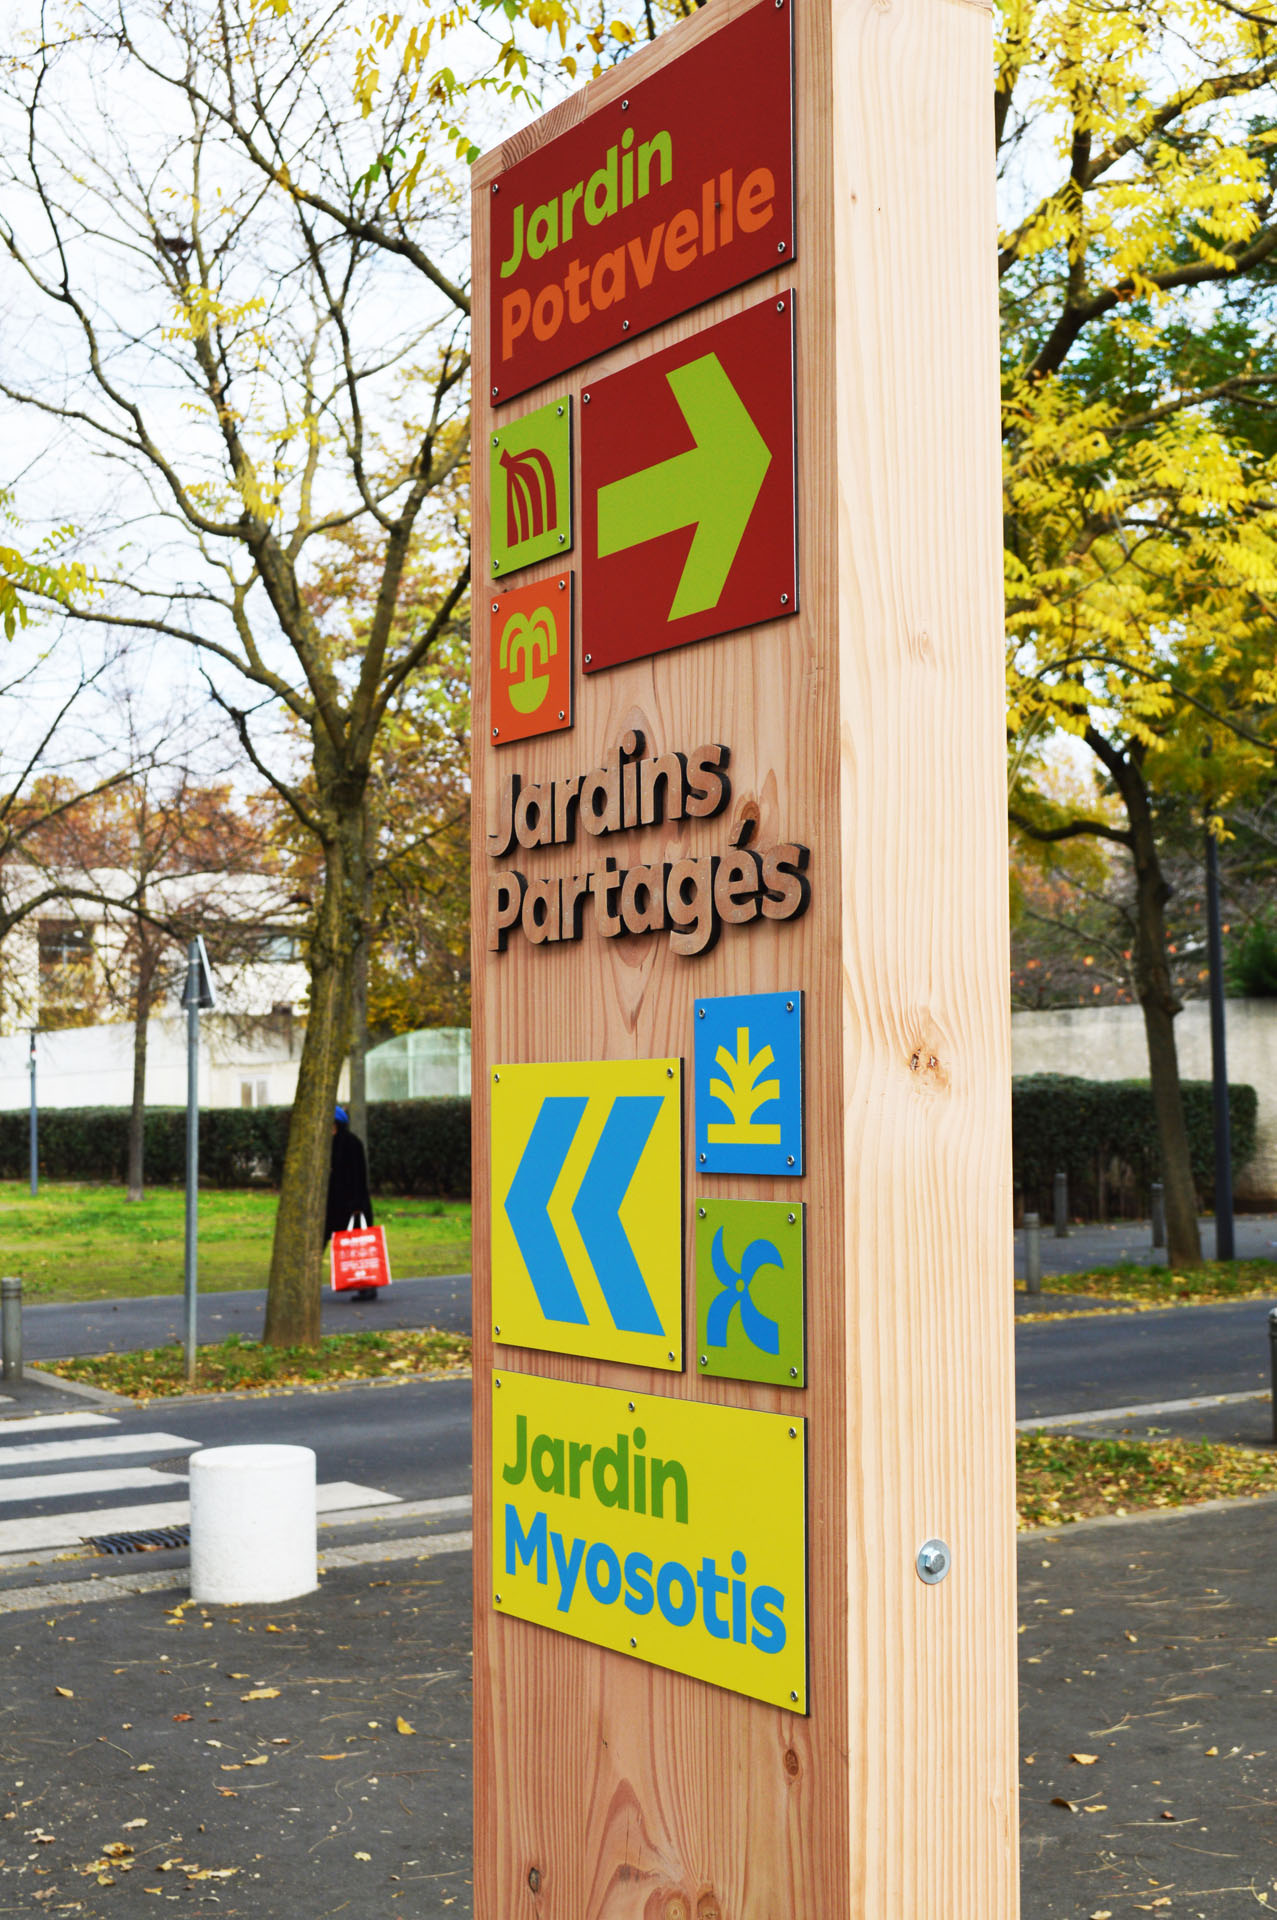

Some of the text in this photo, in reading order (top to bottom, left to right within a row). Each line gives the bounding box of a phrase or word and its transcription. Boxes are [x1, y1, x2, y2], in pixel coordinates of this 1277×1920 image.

[500, 127, 673, 279] Jardin
[502, 167, 776, 362] Potavelle
[487, 729, 731, 857] Jardins
[487, 818, 811, 956] Partagés
[502, 1414, 689, 1525] Jardin
[505, 1503, 787, 1654] Myosotis
